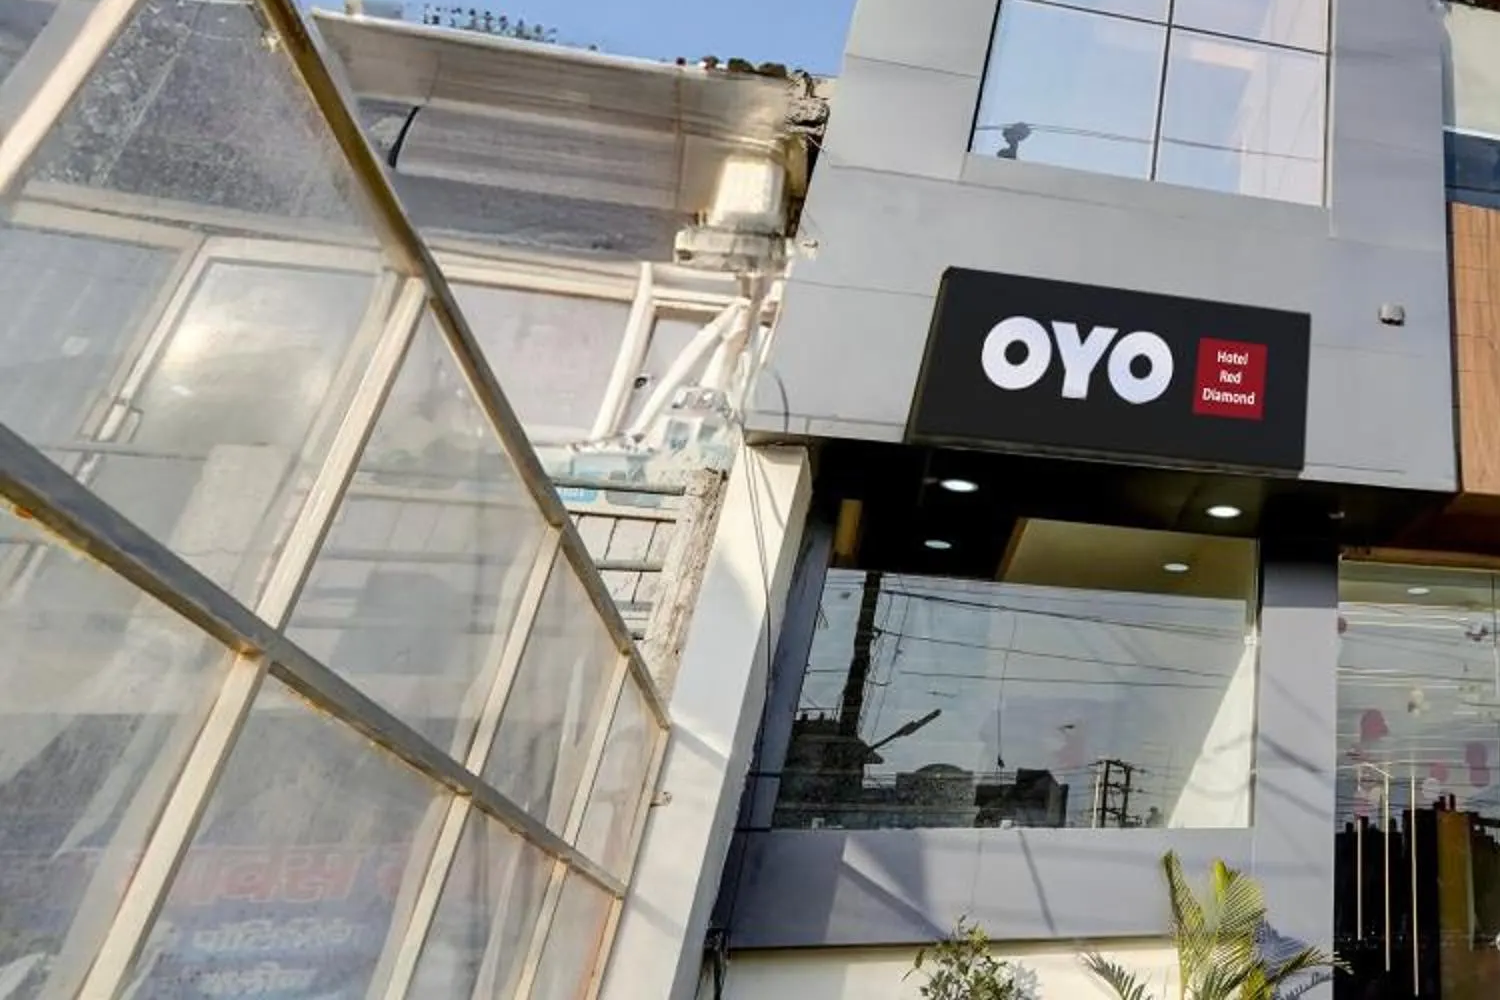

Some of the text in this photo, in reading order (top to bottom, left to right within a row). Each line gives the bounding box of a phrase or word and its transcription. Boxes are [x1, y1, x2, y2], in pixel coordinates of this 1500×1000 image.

[981, 315, 1174, 404] OYO
[1217, 351, 1249, 365] Hotel
[1219, 370, 1242, 384] Red
[1202, 388, 1256, 405] Diamond
